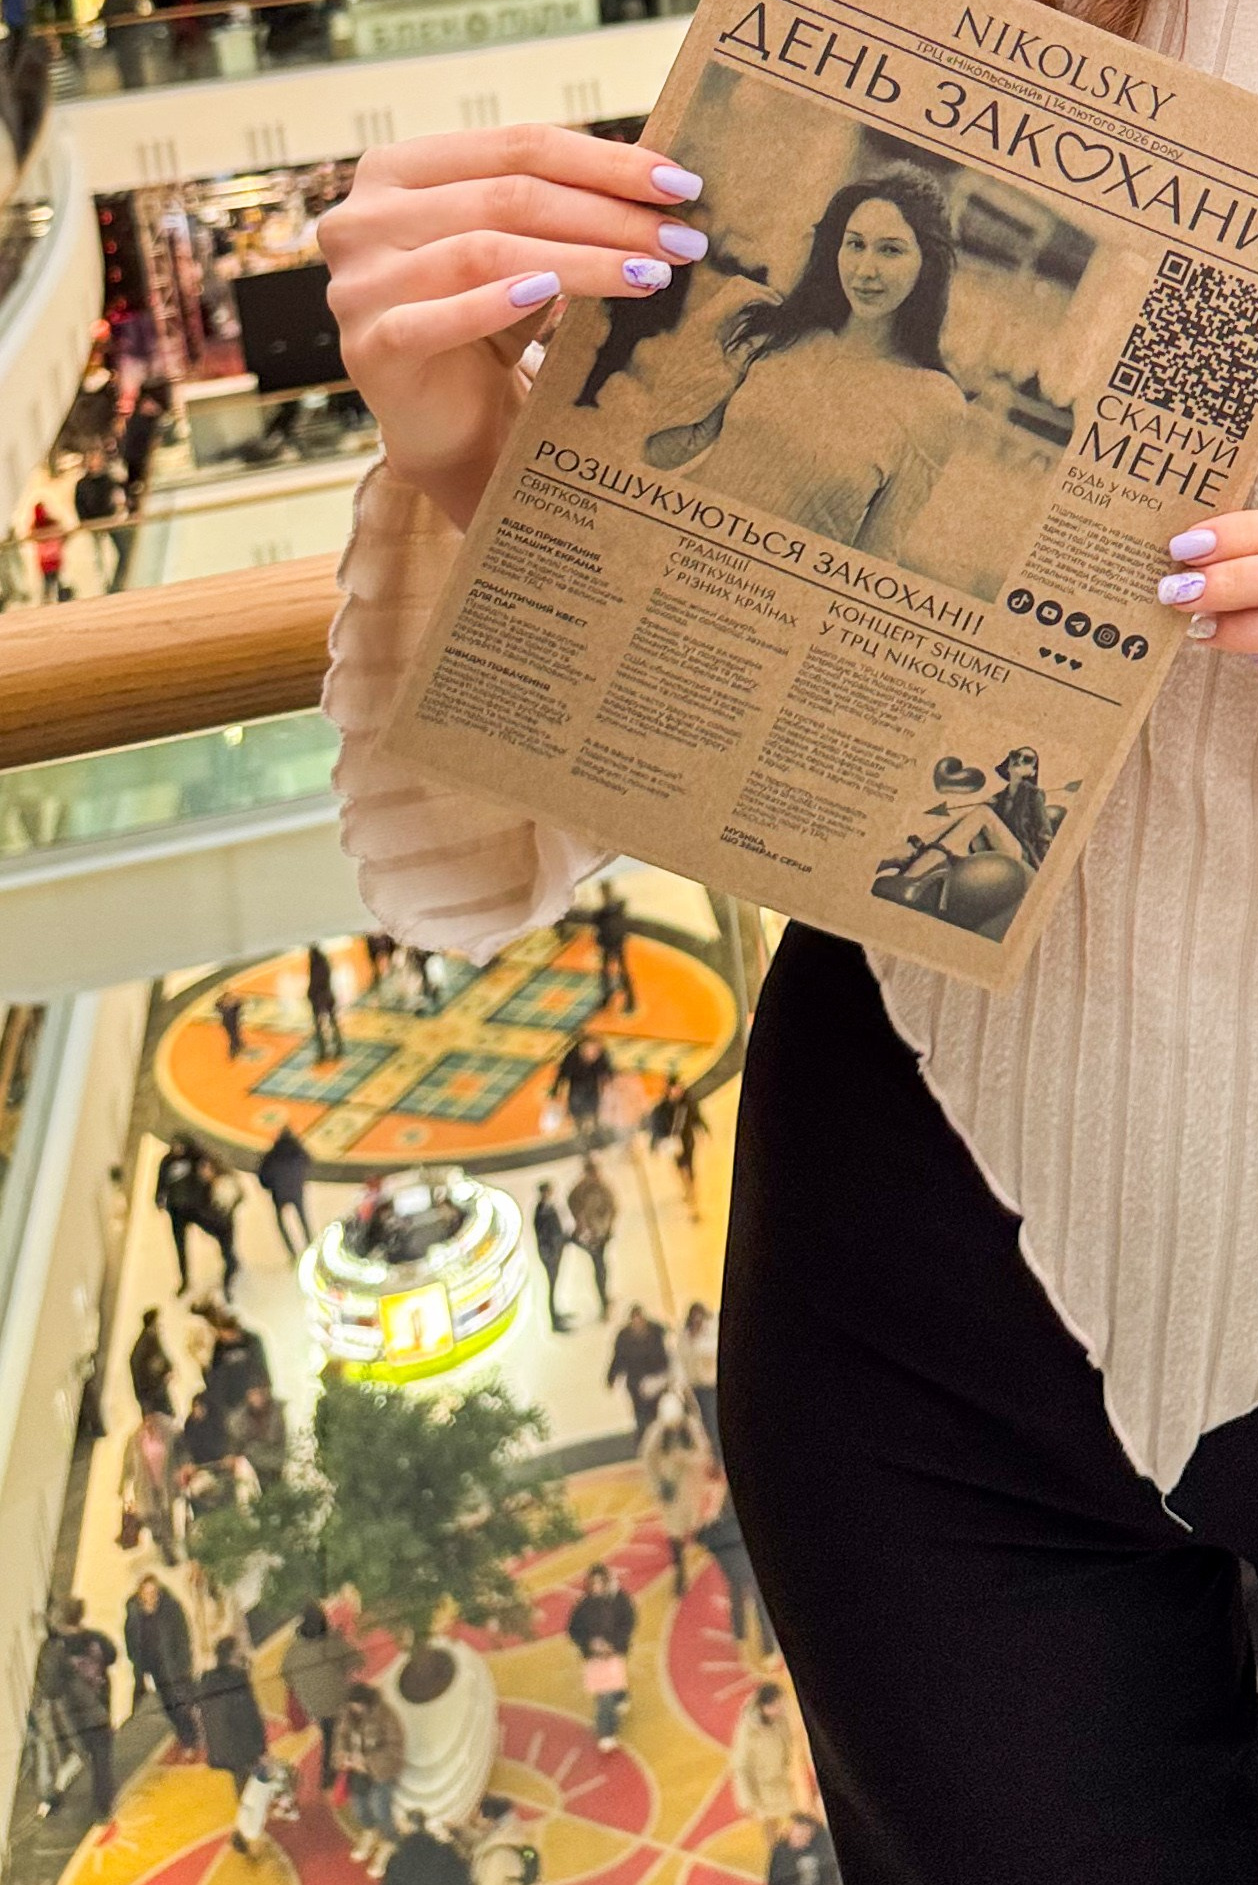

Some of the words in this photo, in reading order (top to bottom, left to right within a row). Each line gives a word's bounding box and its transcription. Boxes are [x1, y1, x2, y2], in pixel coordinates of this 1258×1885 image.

[719, 2, 901, 103] ДЕНЬ
[952, 6, 1176, 121] NIKOLSKY
[912, 40, 945, 65] ТРЦ
[944, 56, 1043, 106] «Нікольський»
[1050, 97, 1066, 115] 14
[1065, 106, 1116, 136] лютого
[1115, 124, 1150, 150] 2026
[1148, 140, 1184, 164] року
[1096, 395, 1240, 469] СКАНУЙ
[1067, 466, 1105, 489] БУДЬ
[1107, 481, 1120, 494] У
[1120, 487, 1163, 512] КУРСІ
[1078, 421, 1229, 508] МЕНЕ
[512, 489, 595, 531] ПРОГРАМА
[520, 474, 598, 514] СВЯТКОВА
[1061, 480, 1112, 509] ПОДІЙ
[496, 527, 512, 539] НА
[514, 533, 554, 555] НАШИХ
[554, 550, 603, 575] ЕКРАНАХ
[501, 517, 535, 535] ВІДЕО
[534, 530, 602, 562] ПРИВІТАННЯ
[535, 440, 806, 563] РОЗШУКУЮТЬСЯ
[813, 551, 985, 635] ЗАКОХАНІ!
[678, 535, 751, 573] ТРАДИЦІЇ
[468, 588, 493, 602] ДЛЯ
[493, 596, 517, 610] ПАР
[662, 564, 676, 578] У
[675, 571, 732, 602] РІЗНИХ
[734, 593, 799, 628] КРАЇНАХ
[669, 551, 776, 602] СВЯТКУВАННЯ
[473, 578, 554, 615] РОМАНТИЧНИЙ
[555, 609, 588, 628] КВЕСТ
[818, 620, 835, 636] У
[840, 628, 880, 658] ТРЦ
[884, 647, 987, 697] NIKOLSKY
[828, 600, 925, 649] КОНЦЕРТ
[930, 641, 1011, 684] SHUMEI
[444, 645, 487, 667] ШВИДКІ
[487, 661, 551, 692] ПОБАЧЕННЯ
[719, 832, 739, 846] ЩО
[739, 840, 779, 861] ЗБИРАЄ
[779, 856, 813, 874] СЕРЦЯ
